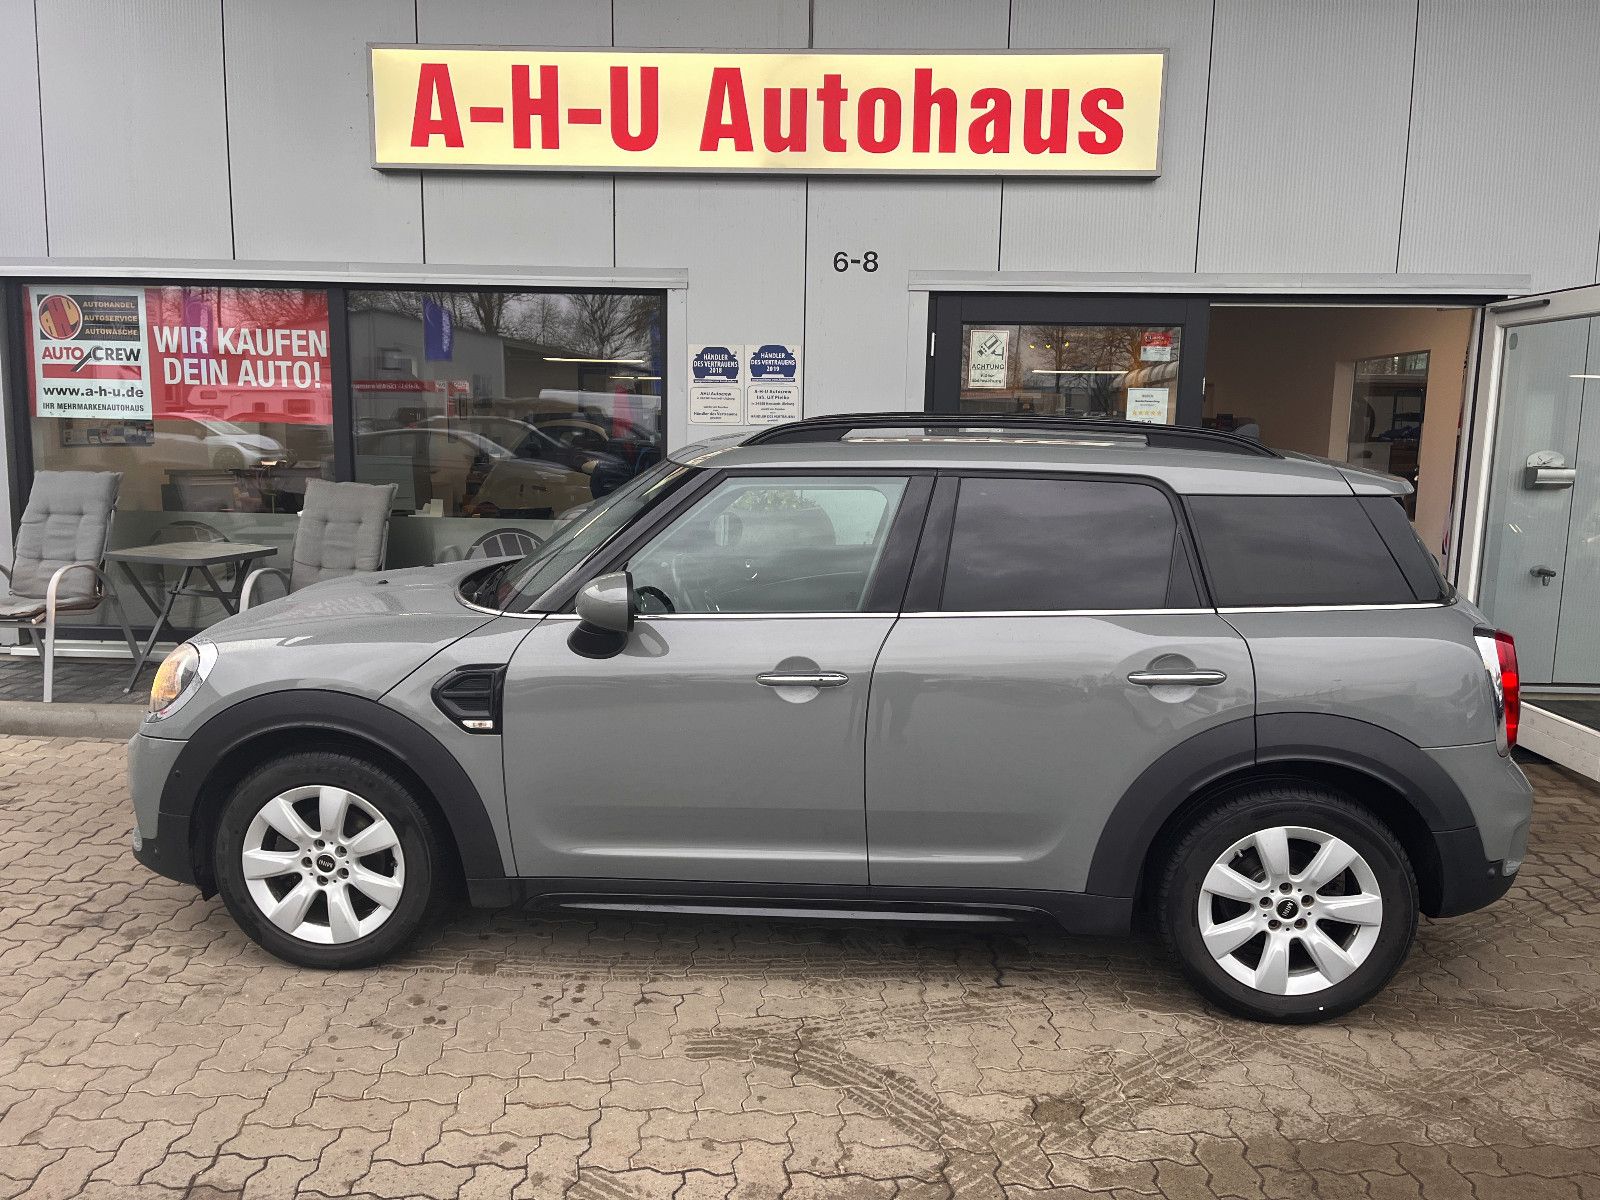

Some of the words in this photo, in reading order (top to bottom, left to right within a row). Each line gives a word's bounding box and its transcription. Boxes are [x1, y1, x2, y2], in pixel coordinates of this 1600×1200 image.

[411, 63, 658, 152] A-H-U
[699, 67, 1124, 155] Autohaus
[833, 251, 879, 273] 6-8
[83, 301, 135, 309] AUTOHANDEL
[84, 314, 138, 322] AUTOSERVICE
[153, 325, 208, 354] WIR
[217, 327, 328, 357] KAUFEN
[42, 346, 84, 360] AUTO
[92, 346, 141, 361] CREW
[704, 360, 738, 368] VERTRAUENS
[163, 357, 228, 386] DEIN
[237, 359, 321, 388] AUTO!
[43, 386, 144, 398] www.a-h-u.de
[56, 402, 144, 412] MEHRMARKENAUTOHAUS
